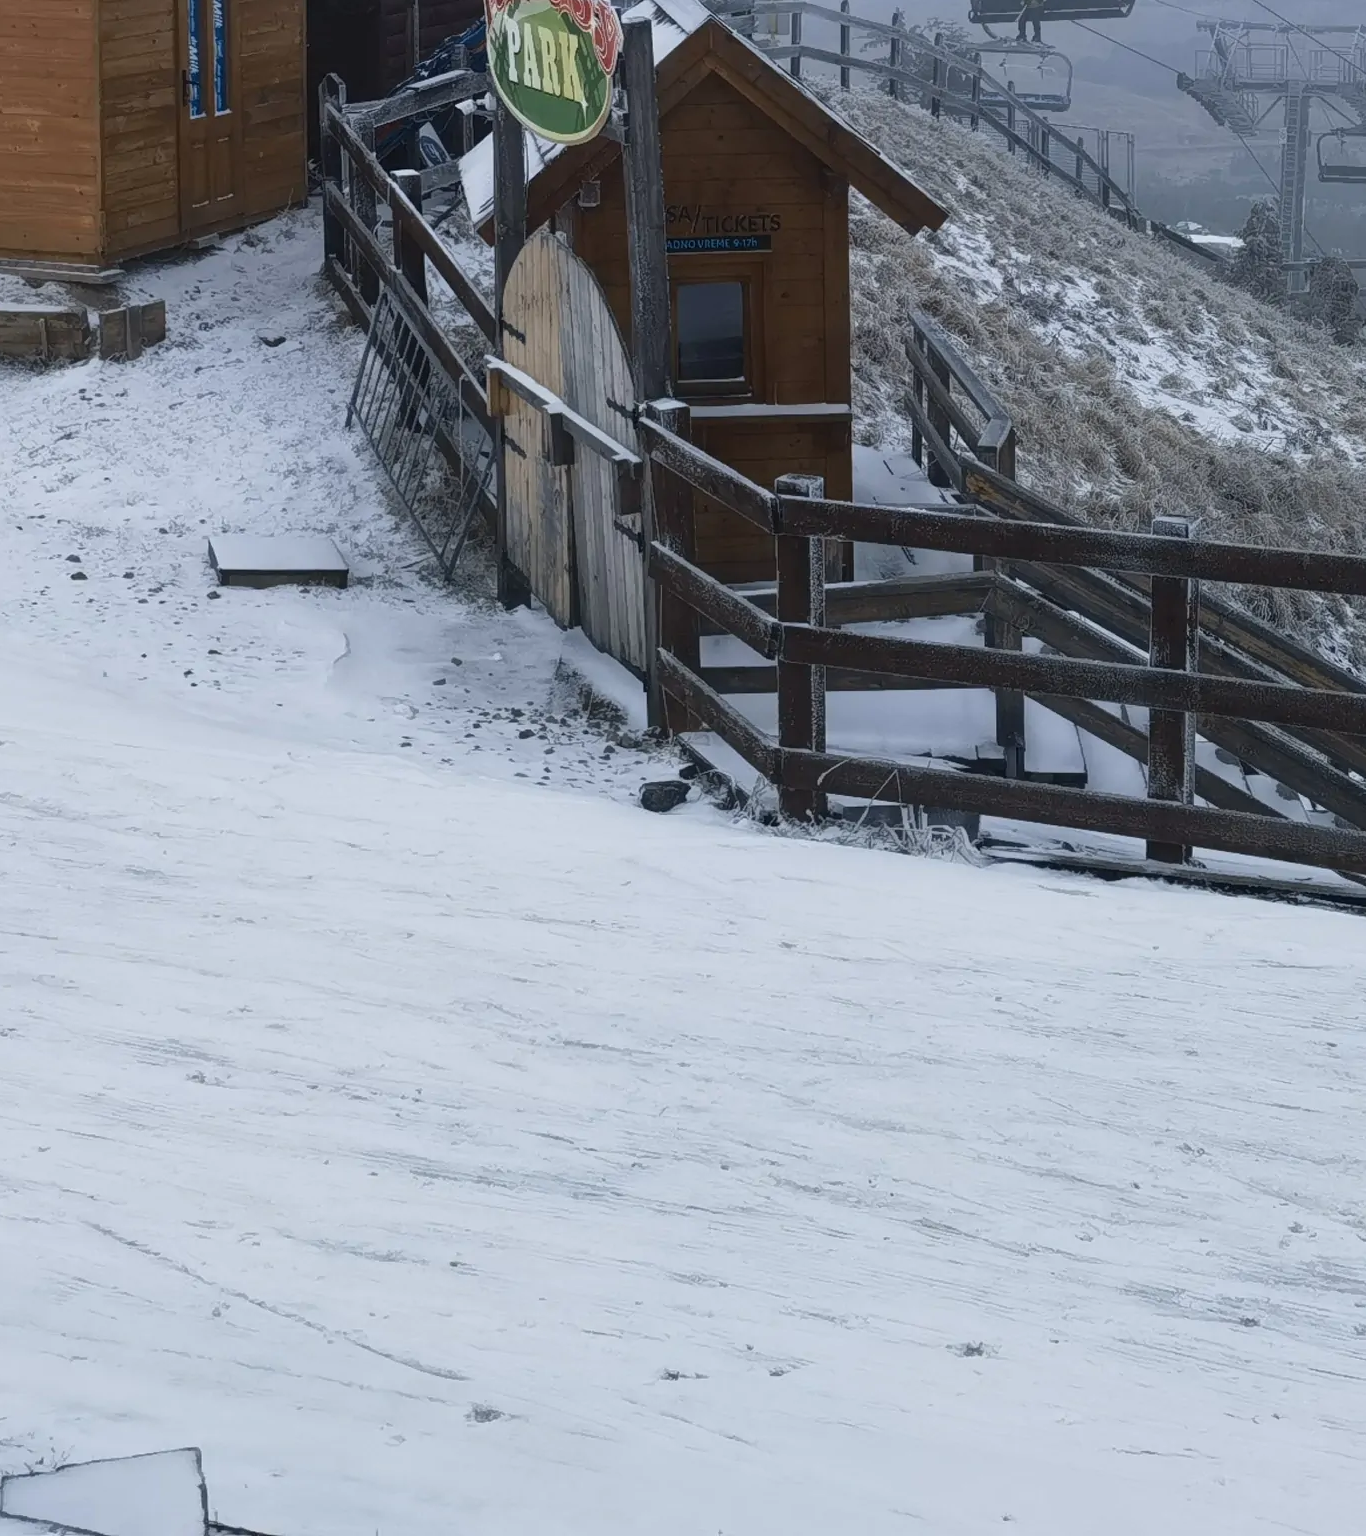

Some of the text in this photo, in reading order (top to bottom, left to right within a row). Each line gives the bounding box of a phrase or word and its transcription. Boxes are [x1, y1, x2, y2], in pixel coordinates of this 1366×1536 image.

[505, 16, 584, 103] PARK
[666, 239, 696, 249] ADNO
[698, 238, 730, 249] VREME
